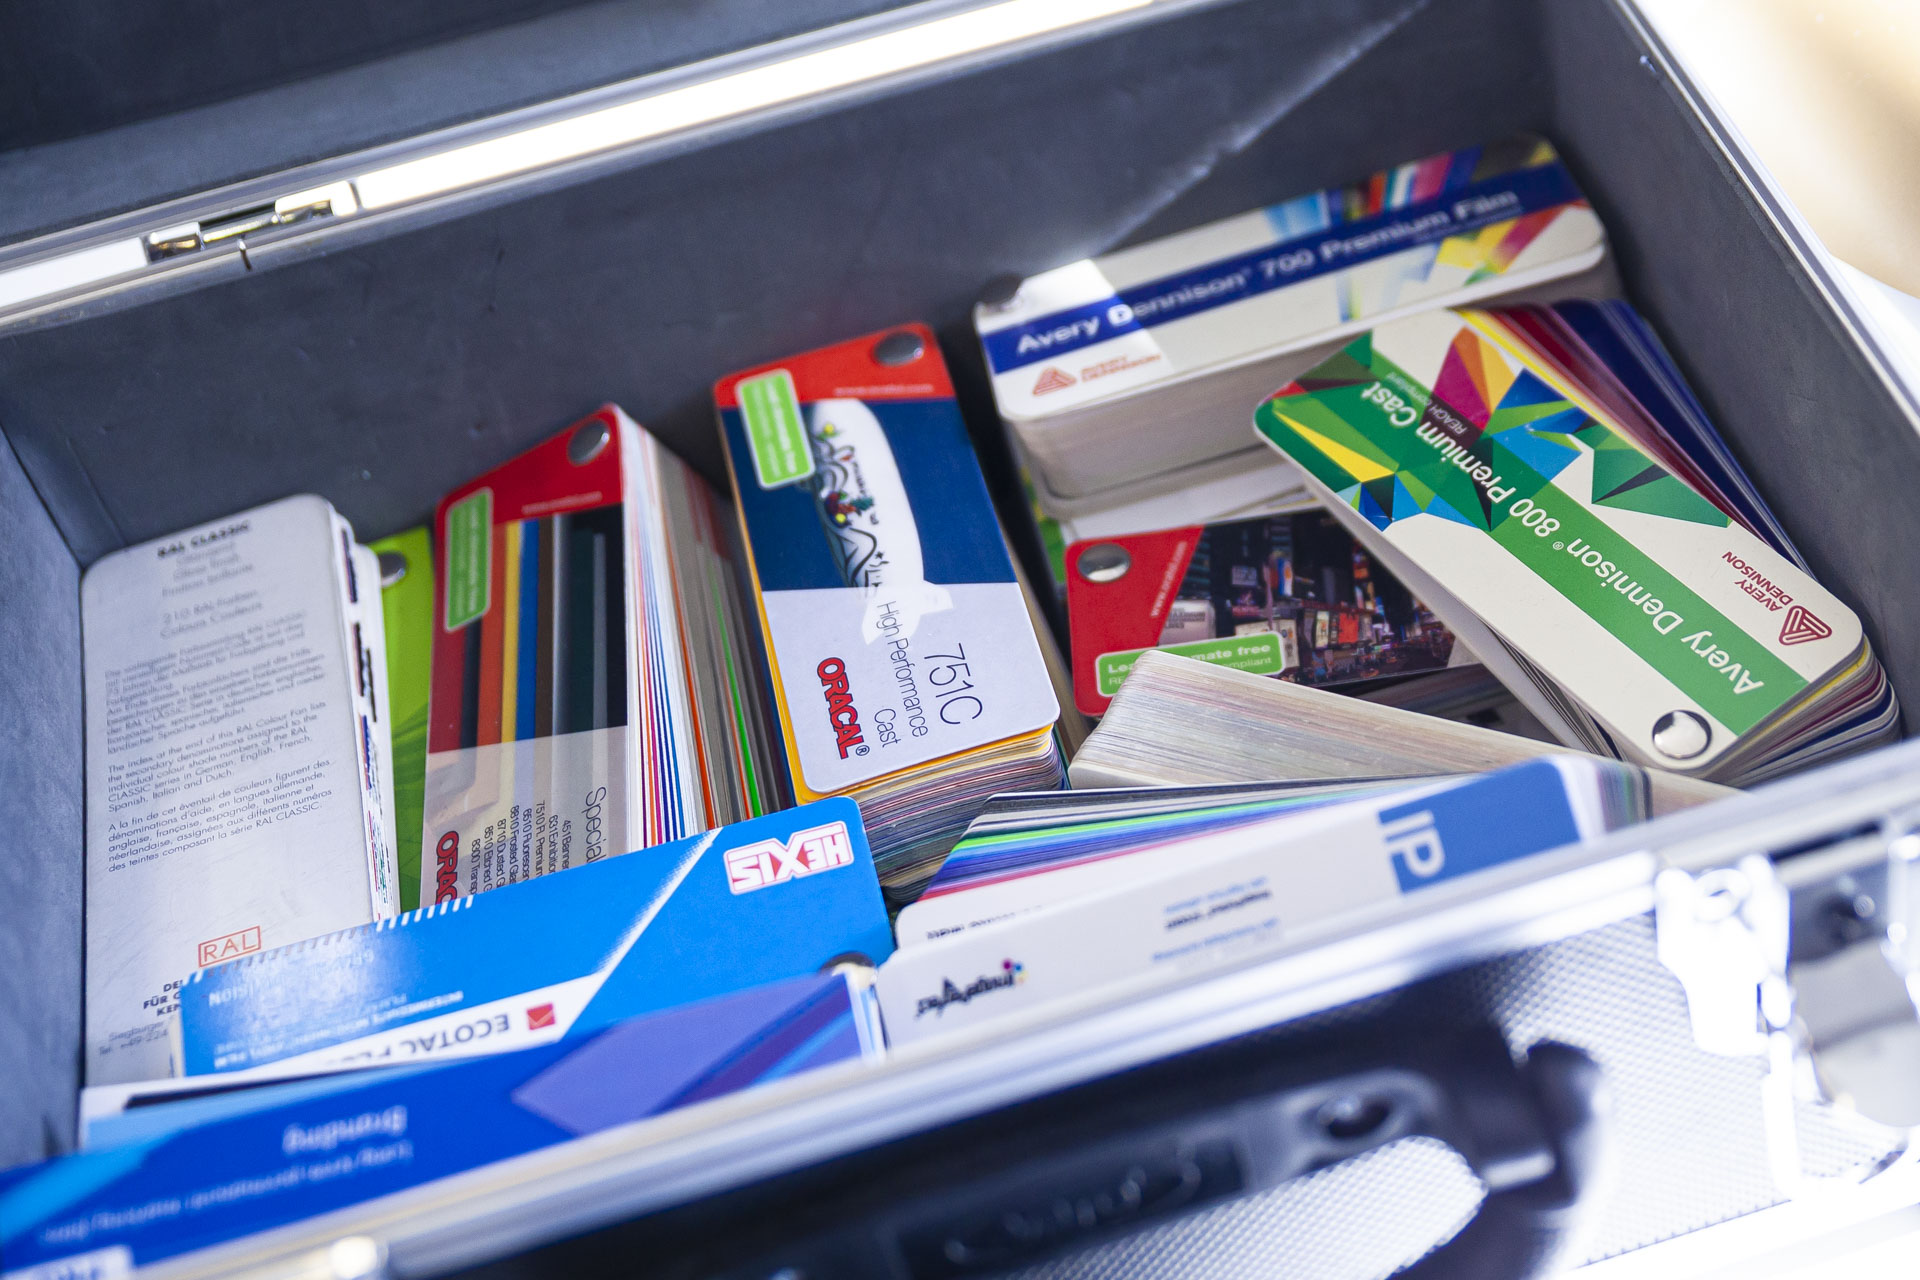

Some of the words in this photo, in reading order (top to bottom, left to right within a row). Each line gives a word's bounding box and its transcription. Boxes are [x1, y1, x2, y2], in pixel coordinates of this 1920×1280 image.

[1016, 315, 1100, 356] Avery
[1259, 248, 1316, 281] 700
[1320, 210, 1450, 262] Premium
[1454, 190, 1520, 221] Film
[1361, 382, 1417, 427] Cast
[1427, 404, 1468, 435] REACH
[1416, 421, 1516, 504] Premium
[1509, 498, 1560, 537] 800
[157, 541, 185, 558] RAL
[190, 520, 249, 547] CLASSIC
[1722, 551, 1793, 606] DENNISON
[1735, 579, 1783, 612] AVERY
[876, 601, 900, 638] High
[1237, 644, 1271, 656] free
[1682, 630, 1764, 694] Avery
[886, 637, 929, 738] Performance
[924, 643, 983, 725] 751C
[874, 708, 900, 748] Cast
[108, 823, 116, 832] A
[119, 819, 128, 828] la
[131, 815, 142, 825] fin
[146, 810, 158, 820] de
[162, 805, 176, 815] cet
[179, 793, 215, 810] éventail
[218, 788, 230, 798] de
[234, 776, 272, 793] couleurs
[275, 764, 310, 784] figurent
[313, 758, 329, 769] des
[108, 814, 177, 842] dénominations
[180, 803, 214, 821] d'aide,
[218, 800, 230, 808] en
[233, 786, 269, 805] langues
[273, 770, 325, 792] allemande,
[535, 800, 546, 825] 7510
[108, 832, 152, 853] anglaise,
[156, 817, 202, 838] française,
[206, 800, 258, 823] espagnole,
[262, 787, 302, 804] italienne
[108, 836, 173, 863] néerlandaise,
[176, 821, 223, 842] assignées
[226, 817, 243, 826] aux
[247, 801, 289, 820] différents
[292, 788, 332, 805] numéros
[108, 861, 125, 872] des
[129, 851, 159, 866] teintes
[162, 834, 214, 858] composant
[217, 830, 226, 839] la
[230, 822, 252, 835] série
[256, 815, 272, 827] RAL
[276, 800, 322, 821] CLASSIC.
[496, 819, 507, 843] 8710
[509, 805, 520, 830] 8810
[522, 808, 532, 832] 6510
[548, 815, 559, 832] 631
[562, 819, 572, 836] 451
[470, 838, 481, 863] 8300
[483, 826, 494, 850] 8510
[509, 830, 519, 863] Frosted
[434, 830, 459, 906] ORAC
[482, 850, 493, 883] Etched
[495, 843, 506, 876] Dusted
[521, 833, 533, 881] Fluorescen
[725, 823, 852, 893] HEXIS
[468, 864, 480, 895] Transp
[203, 933, 257, 962] RAL
[143, 995, 168, 1009] FÜR
